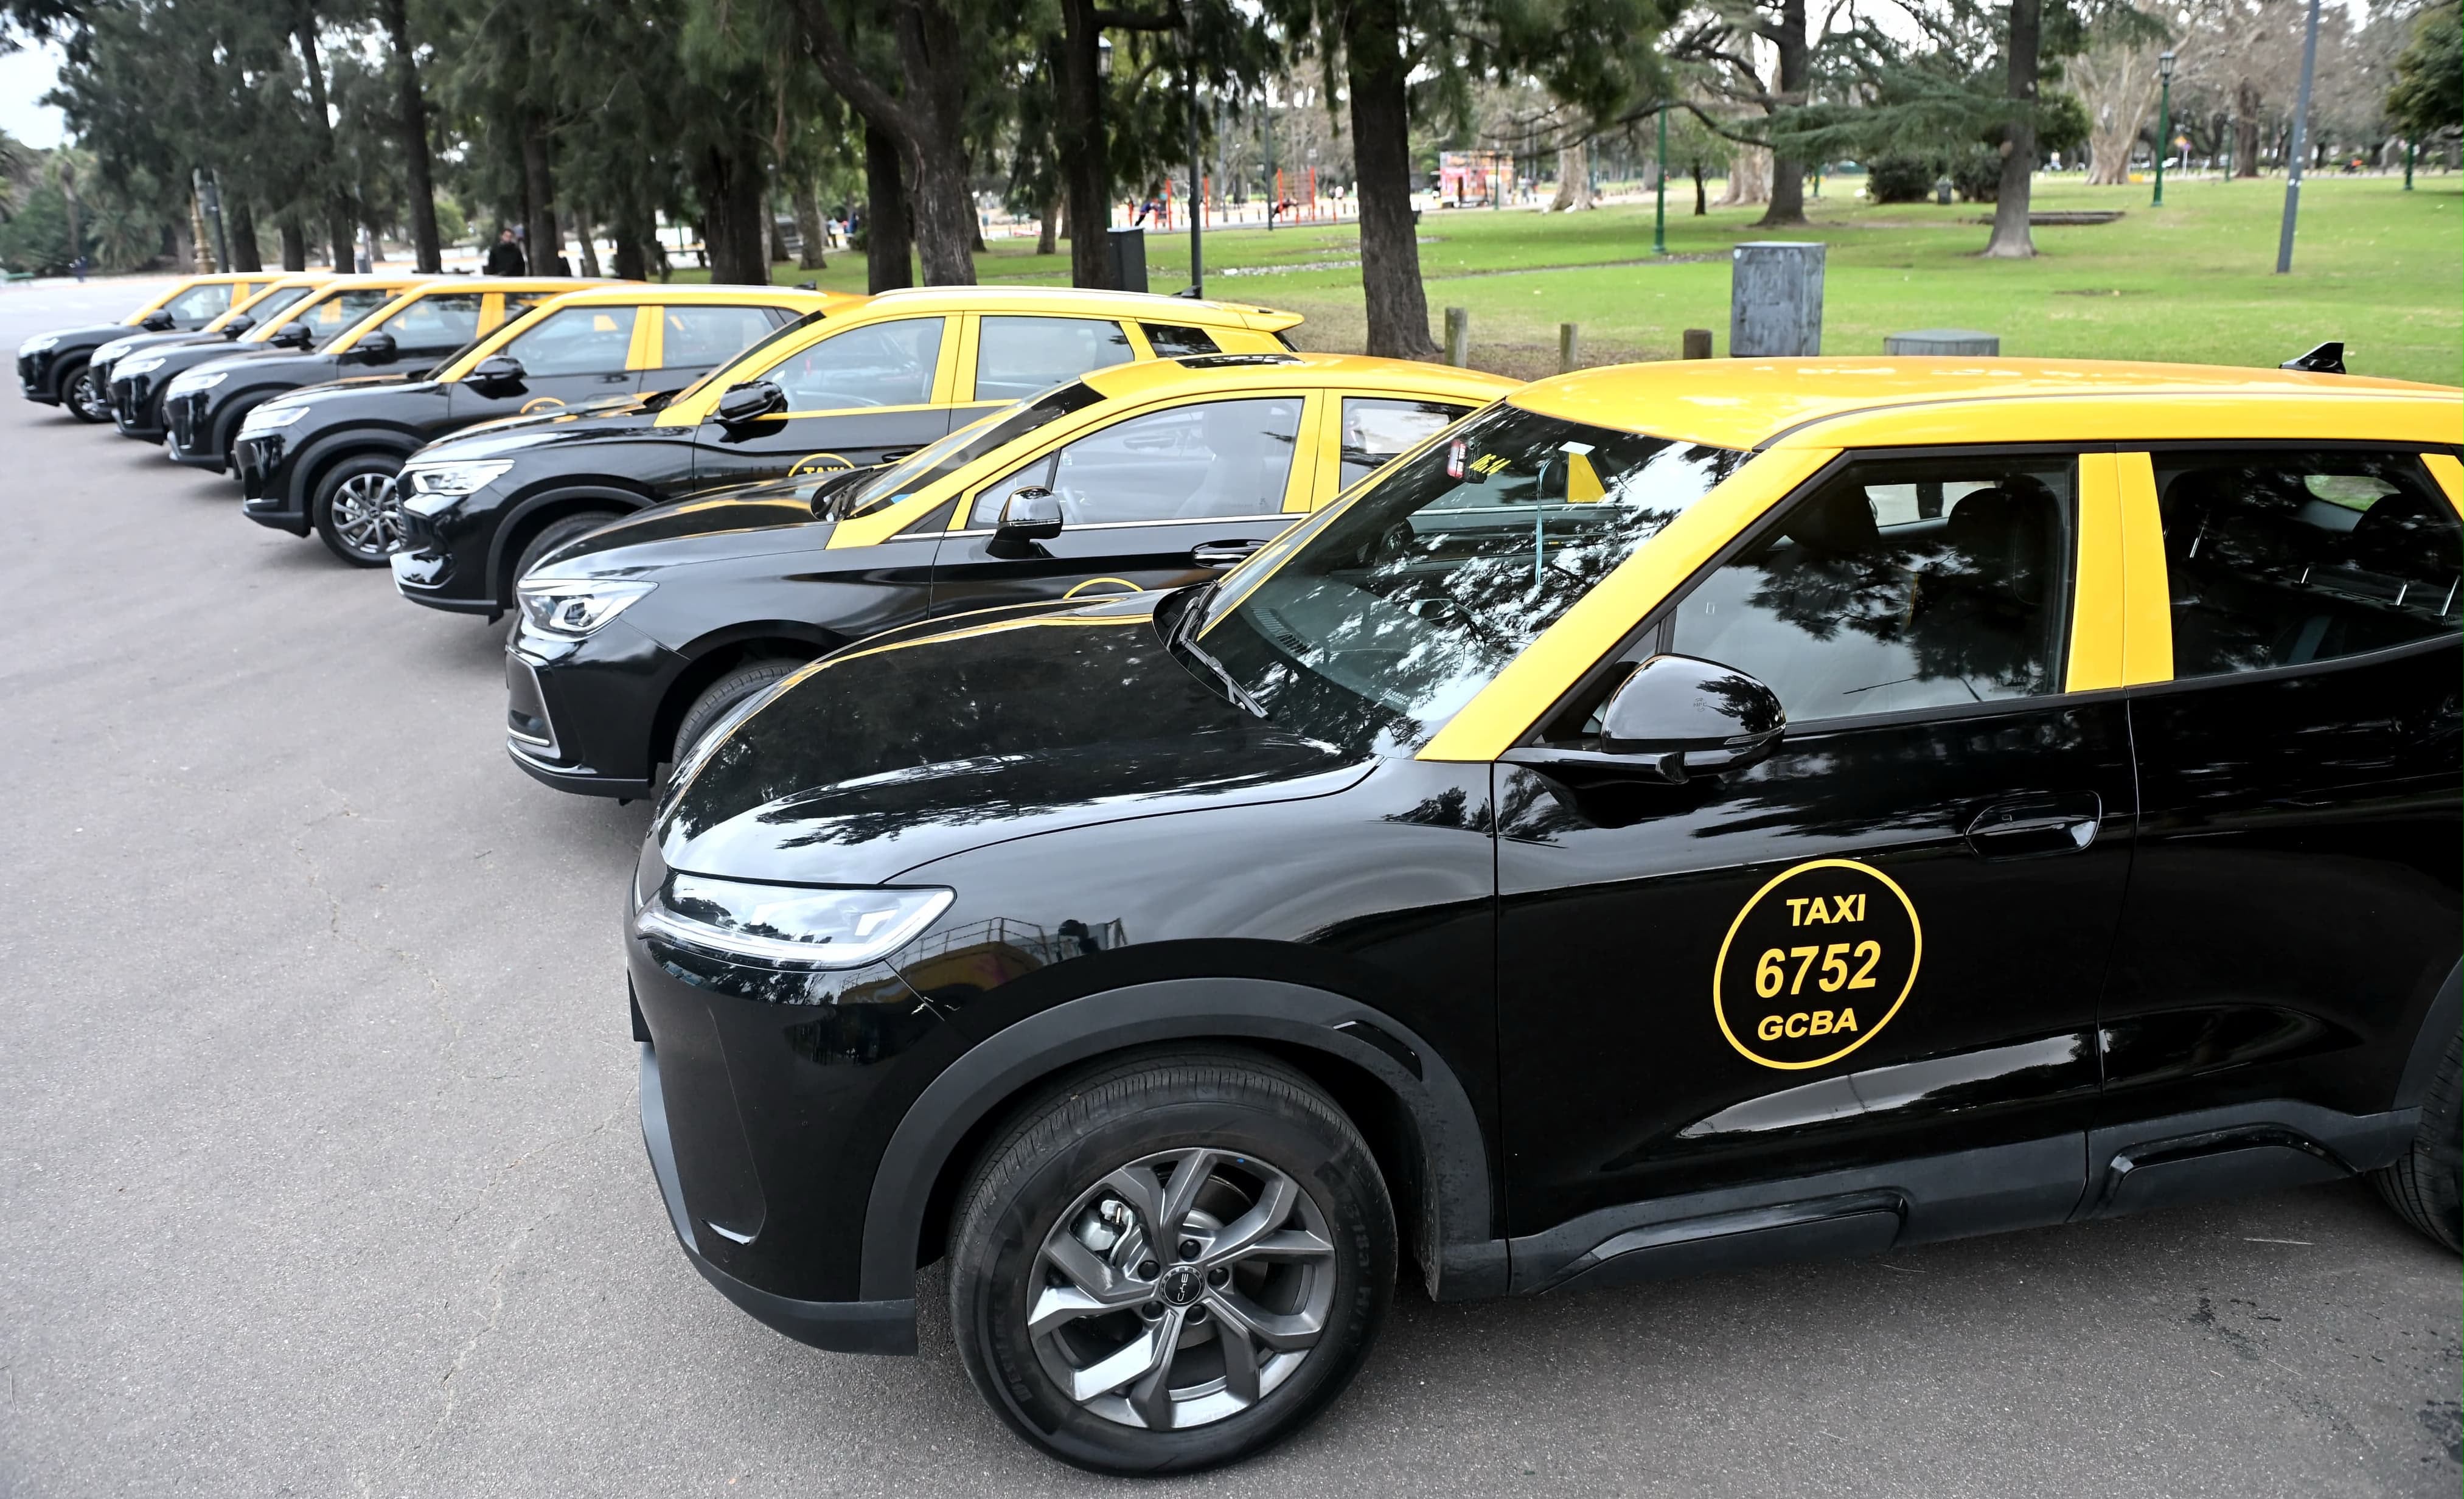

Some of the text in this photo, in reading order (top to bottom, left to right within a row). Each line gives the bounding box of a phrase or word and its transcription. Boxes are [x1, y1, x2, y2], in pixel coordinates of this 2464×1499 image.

[1786, 894, 1866, 927] TAXI
[1756, 941, 1881, 998] 6752
[1758, 1008, 1858, 1041] GCBA
